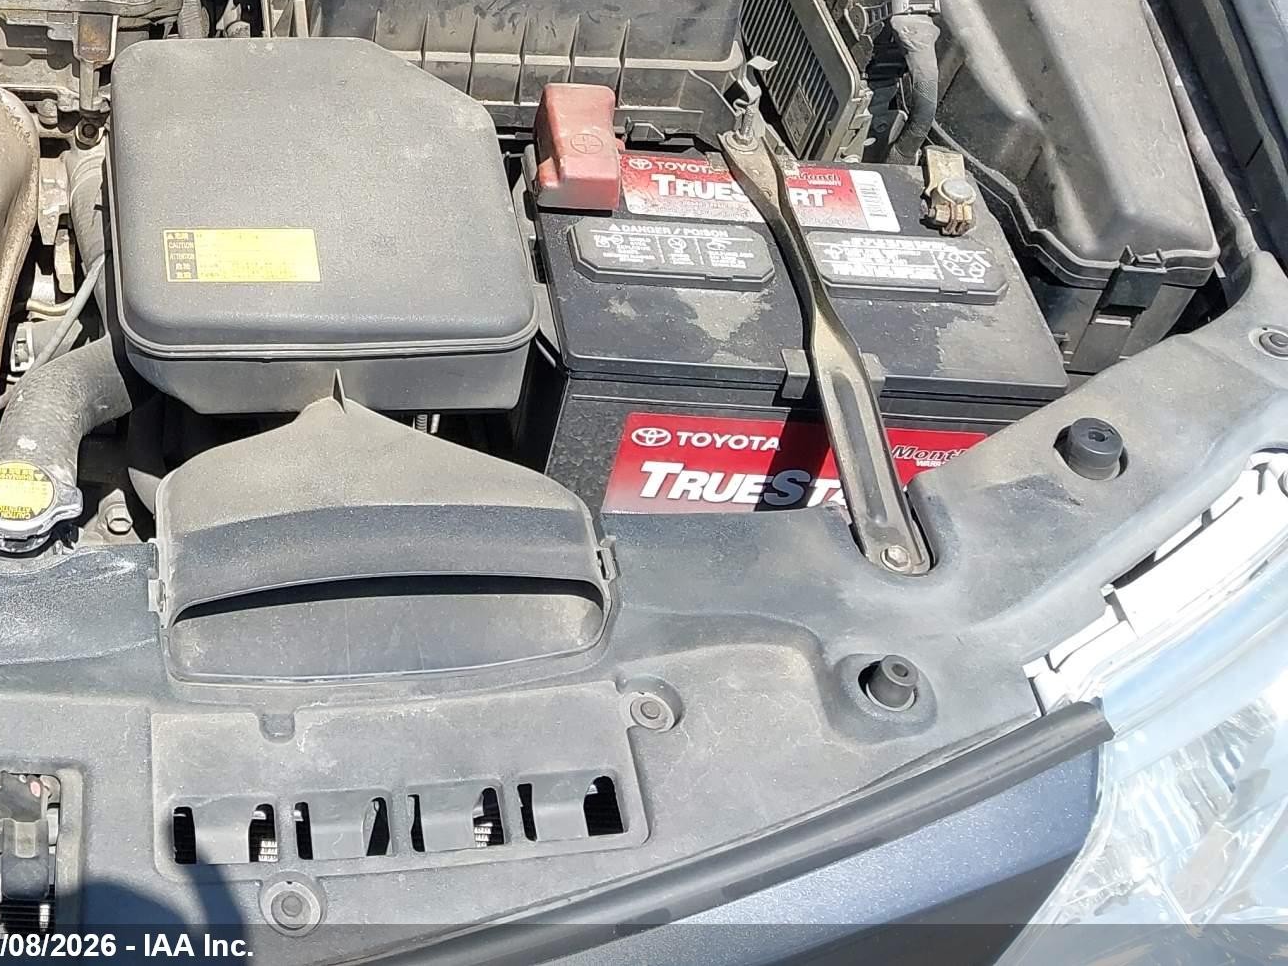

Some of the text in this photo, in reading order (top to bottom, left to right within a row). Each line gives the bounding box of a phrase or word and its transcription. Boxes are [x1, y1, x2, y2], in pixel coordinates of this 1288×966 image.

[655, 161, 718, 174] TOYOT
[621, 224, 671, 235] DANGER
[676, 431, 781, 451] TOYOTA
